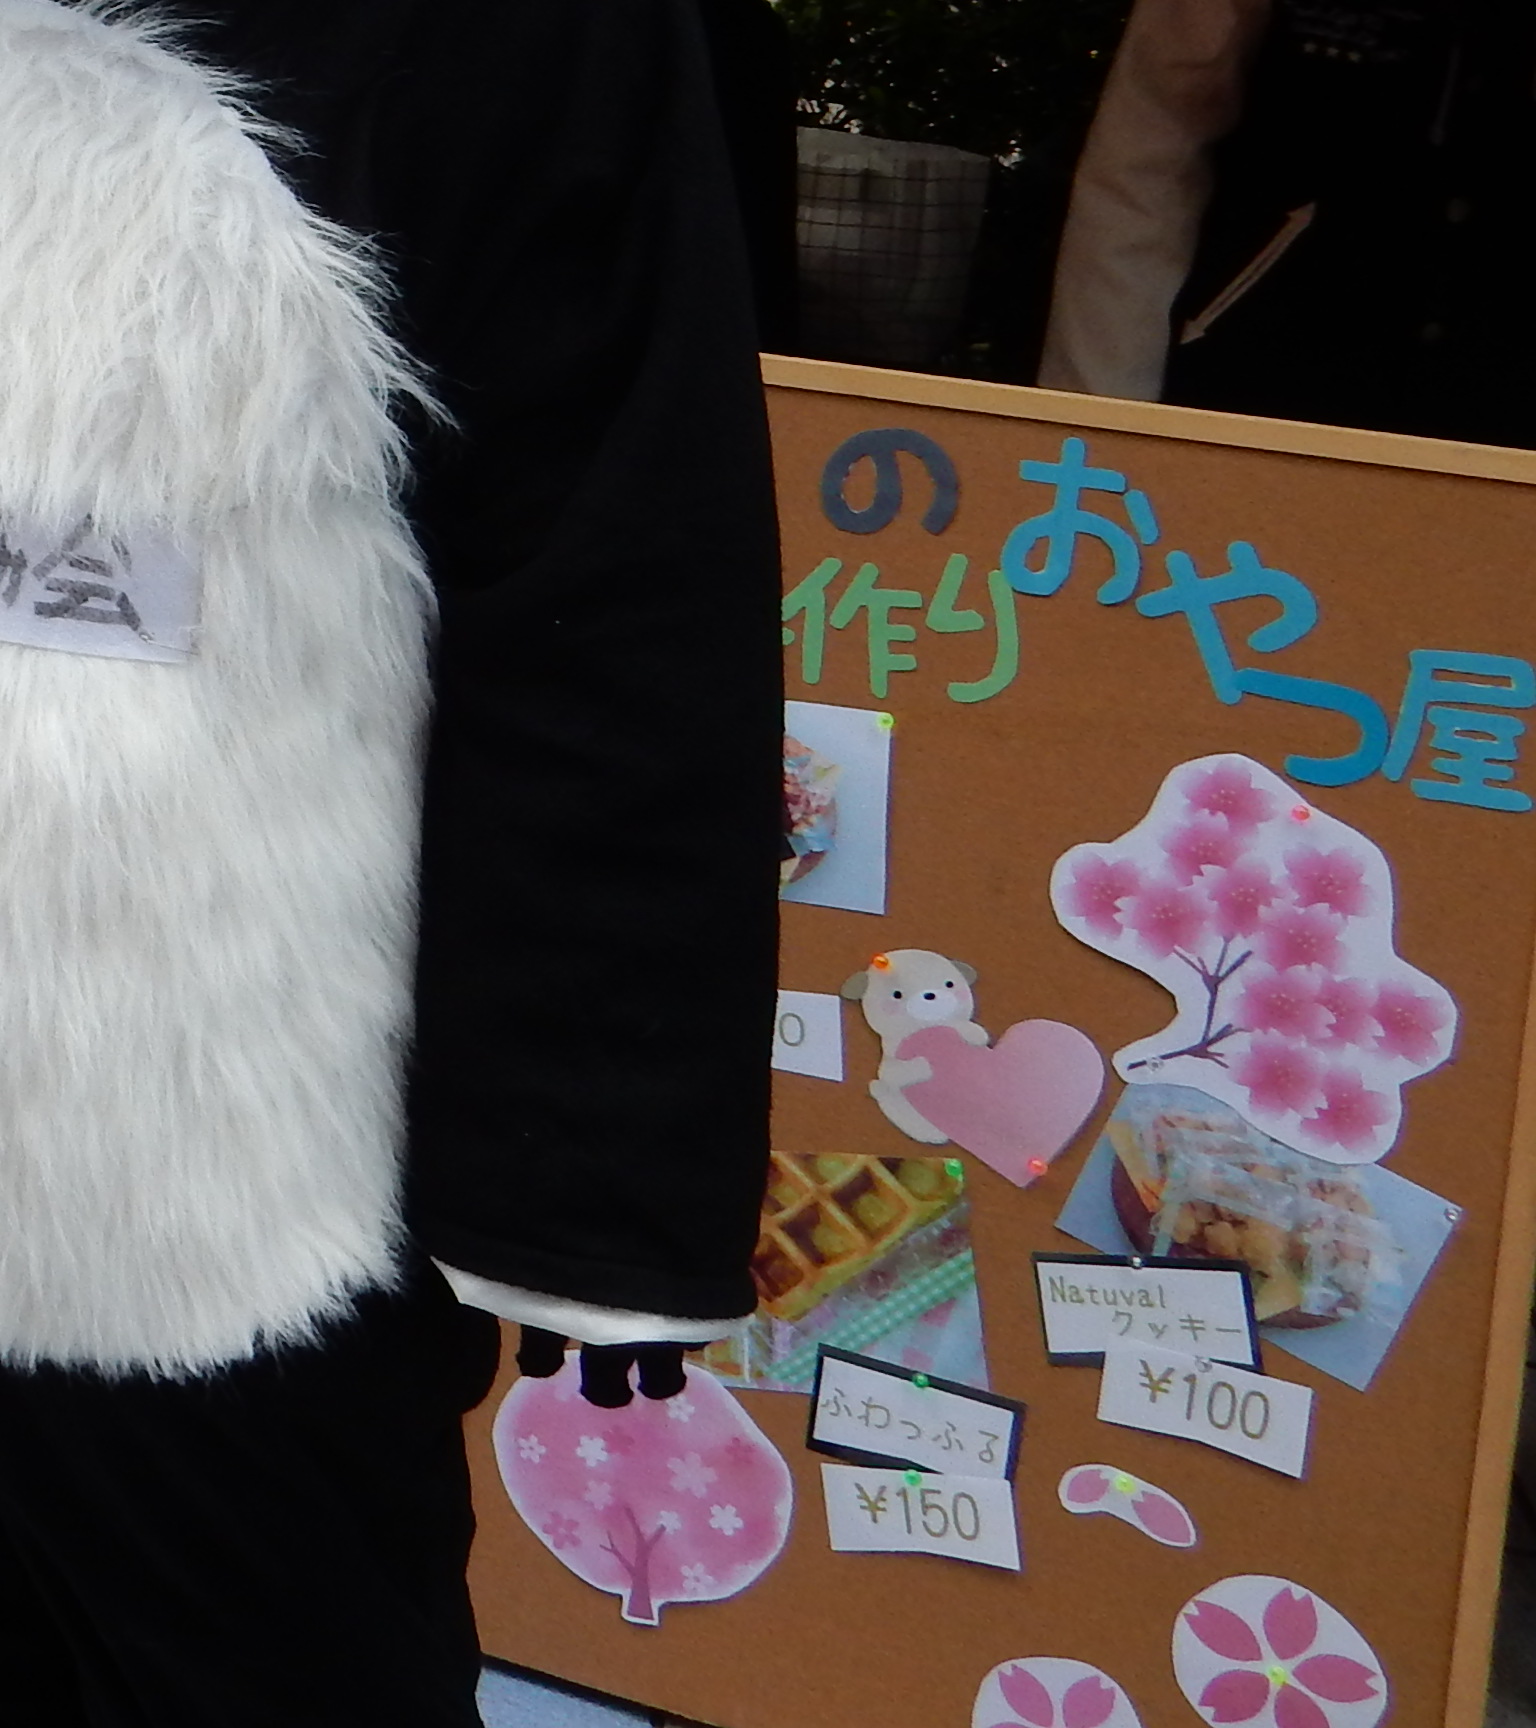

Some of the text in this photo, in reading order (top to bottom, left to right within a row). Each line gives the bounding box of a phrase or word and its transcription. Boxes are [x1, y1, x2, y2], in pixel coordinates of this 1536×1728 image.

[781, 553, 1020, 703] 作り
[1000, 437, 1535, 813] おやつ屋
[1111, 1310, 1243, 1342] クッキー
[1138, 1358, 1271, 1440] ¥100
[854, 1482, 981, 1541] ¥150
